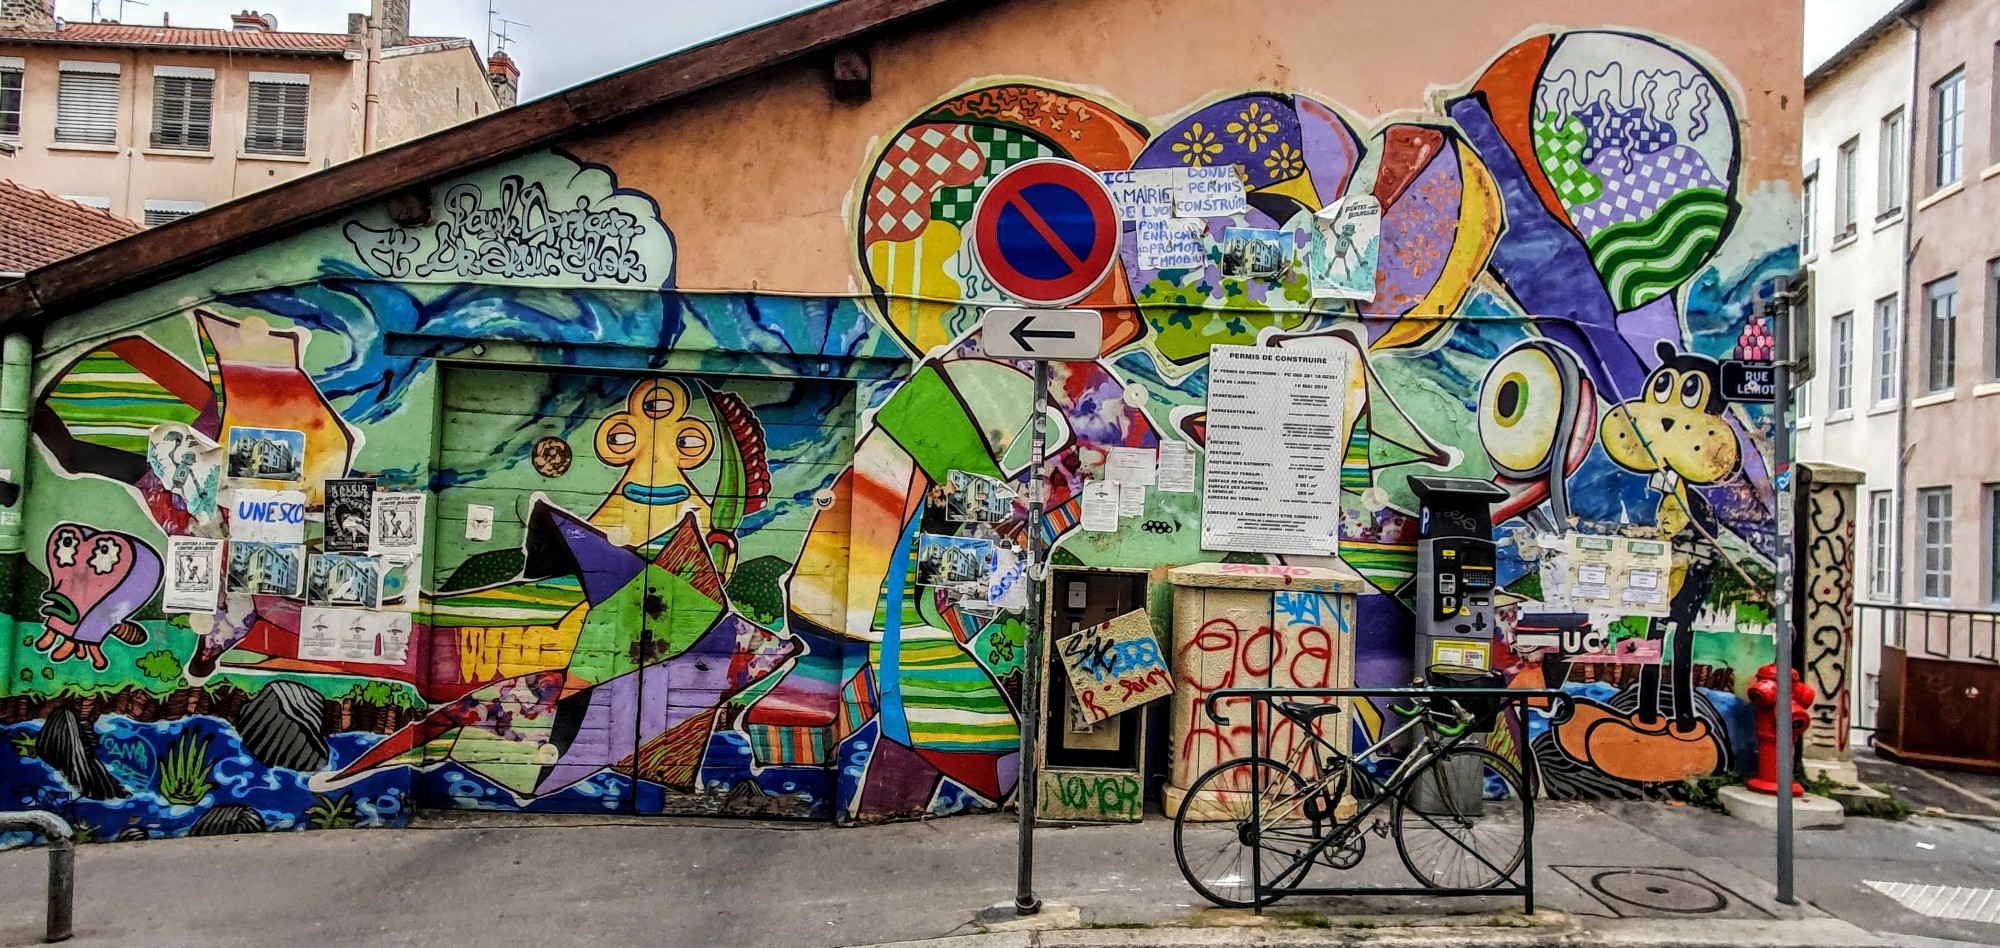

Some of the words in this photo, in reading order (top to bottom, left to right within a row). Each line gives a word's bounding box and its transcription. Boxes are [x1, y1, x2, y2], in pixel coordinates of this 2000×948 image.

[1103, 171, 1136, 185] ICI
[1187, 180, 1242, 194] PERMIS
[1229, 352, 1260, 360] PERMIS
[1275, 355, 1328, 364] CONSTRUIRE
[1745, 371, 1769, 382] RUE
[238, 501, 304, 524] UNESCO
